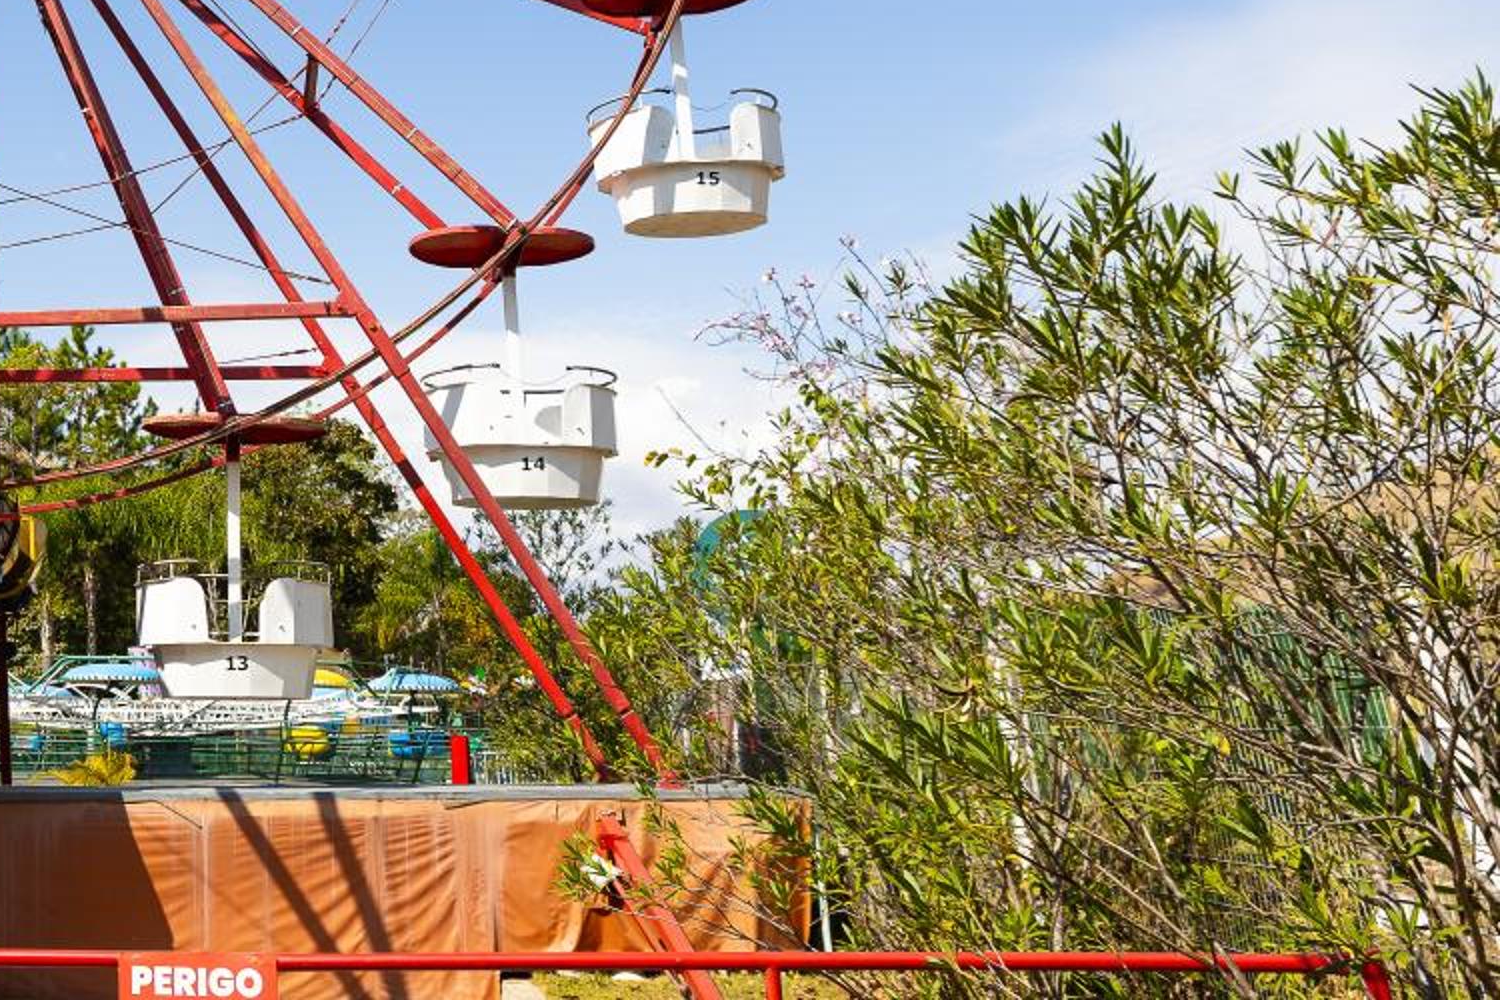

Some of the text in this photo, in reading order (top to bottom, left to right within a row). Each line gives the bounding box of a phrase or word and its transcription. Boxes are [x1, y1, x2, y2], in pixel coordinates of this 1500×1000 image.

[697, 172, 720, 185] 15
[521, 458, 545, 471] 14
[227, 657, 248, 670] 13
[131, 965, 263, 998] PERIGO
